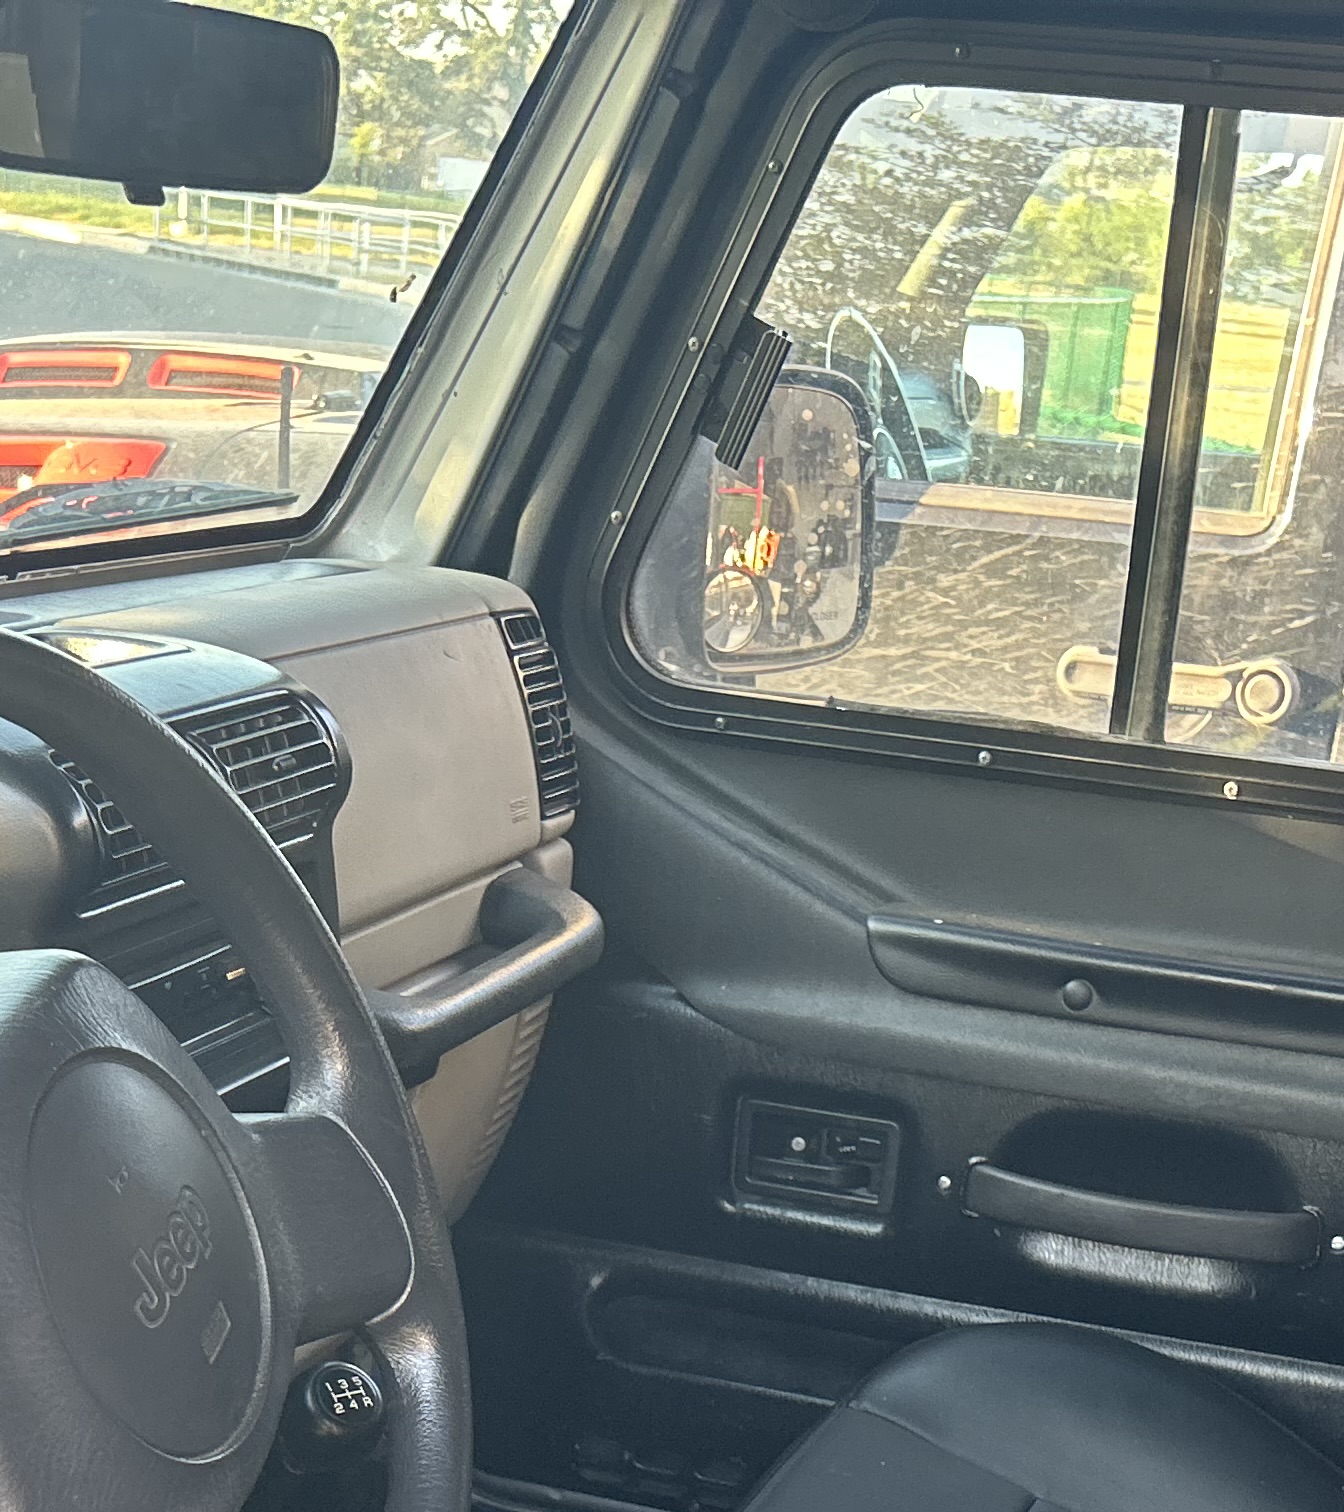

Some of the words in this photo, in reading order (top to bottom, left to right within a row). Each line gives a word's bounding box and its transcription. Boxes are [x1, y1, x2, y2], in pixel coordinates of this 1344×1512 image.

[132, 1184, 214, 1329] Jeep
[337, 1378, 349, 1389] 3
[351, 1376, 363, 1386] 5
[333, 1402, 346, 1415] 2
[349, 1399, 359, 1410] 4
[362, 1396, 374, 1407] R
